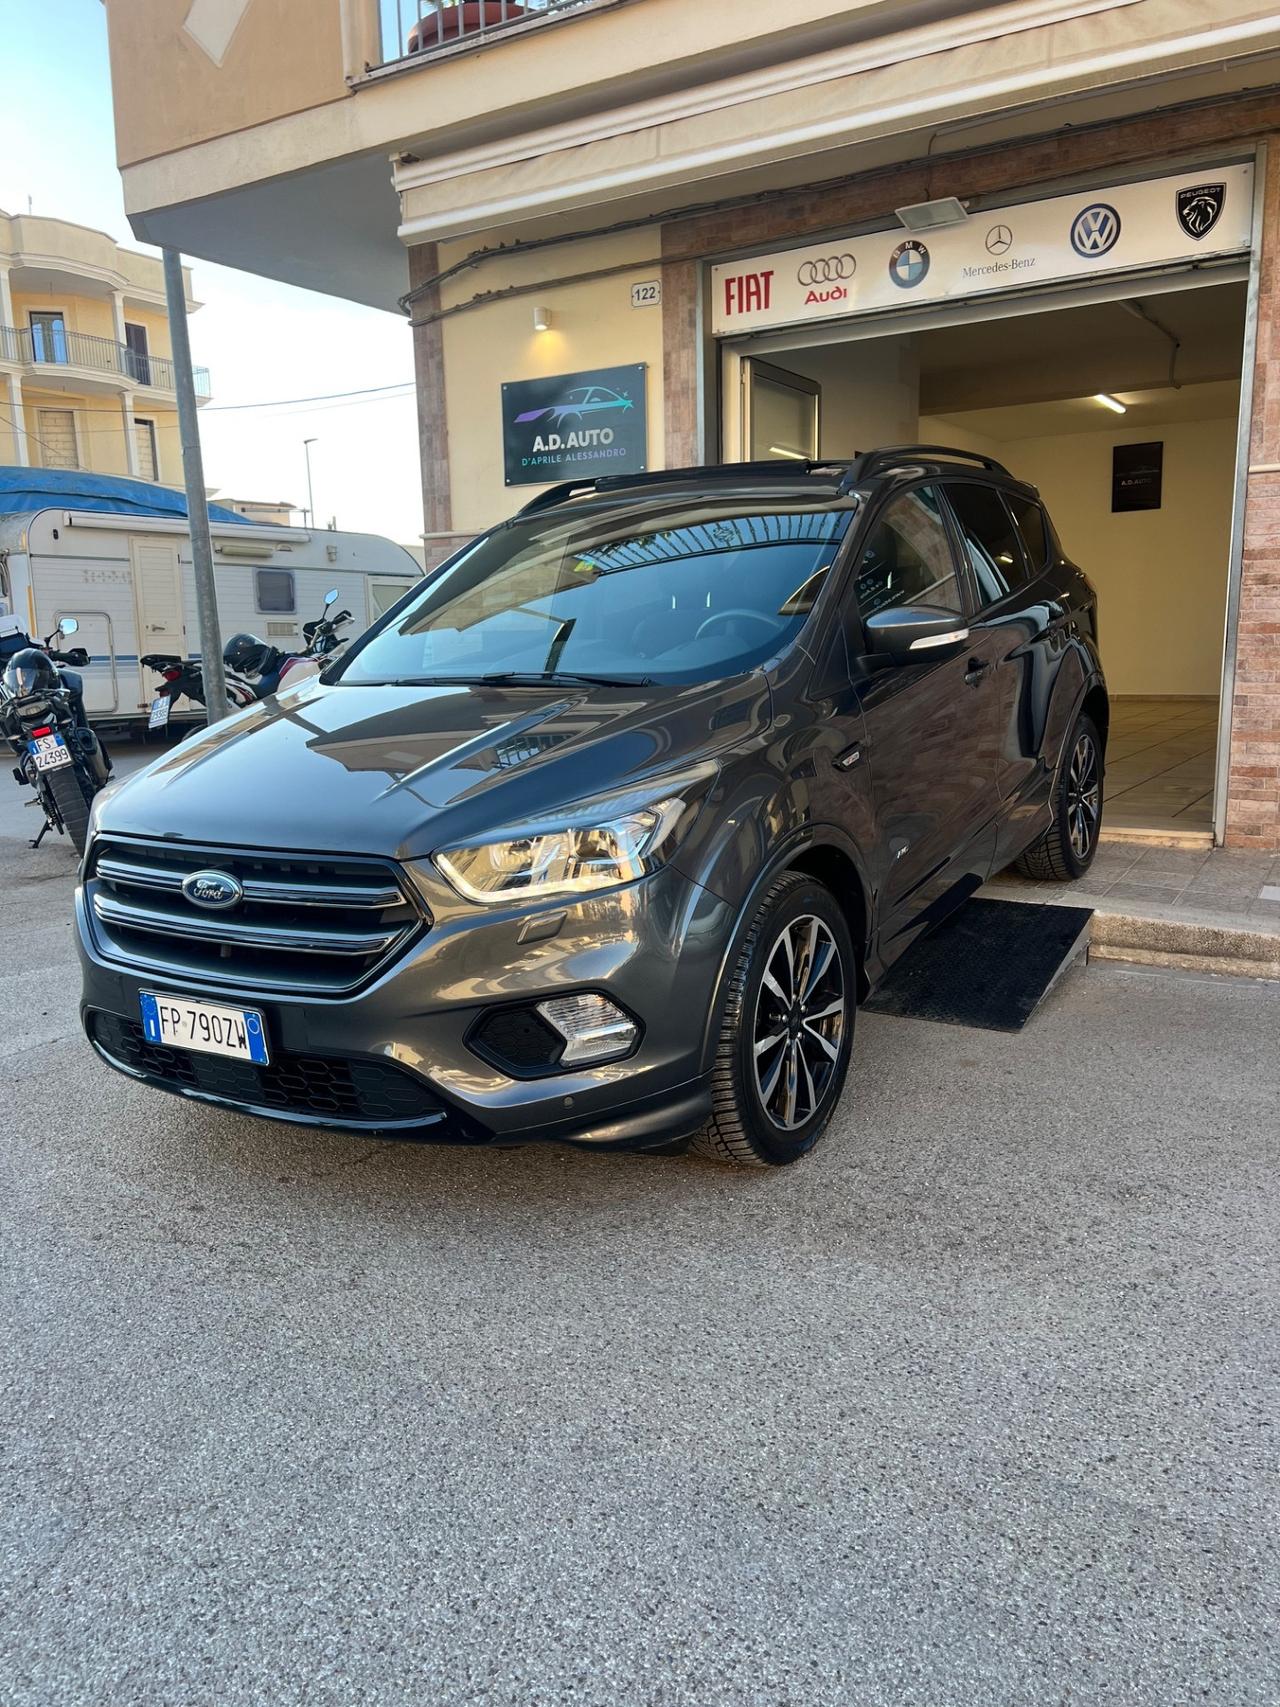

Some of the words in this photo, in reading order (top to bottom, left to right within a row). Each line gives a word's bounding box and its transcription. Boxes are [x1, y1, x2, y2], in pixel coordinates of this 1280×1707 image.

[1180, 187, 1222, 199] PEUGEOT
[893, 241, 927, 259] BMW
[962, 257, 1036, 278] Mercedes-Benz
[634, 286, 656, 301] 122
[725, 270, 774, 316] FIAT
[804, 286, 848, 305] Audi
[521, 454, 562, 466] D'APRILE
[565, 447, 626, 462] ALESSANDRO
[36, 748, 69, 768] 24399
[193, 879, 225, 900] Ford
[159, 1005, 181, 1037] FP
[186, 1010, 248, 1051] 790ZW
